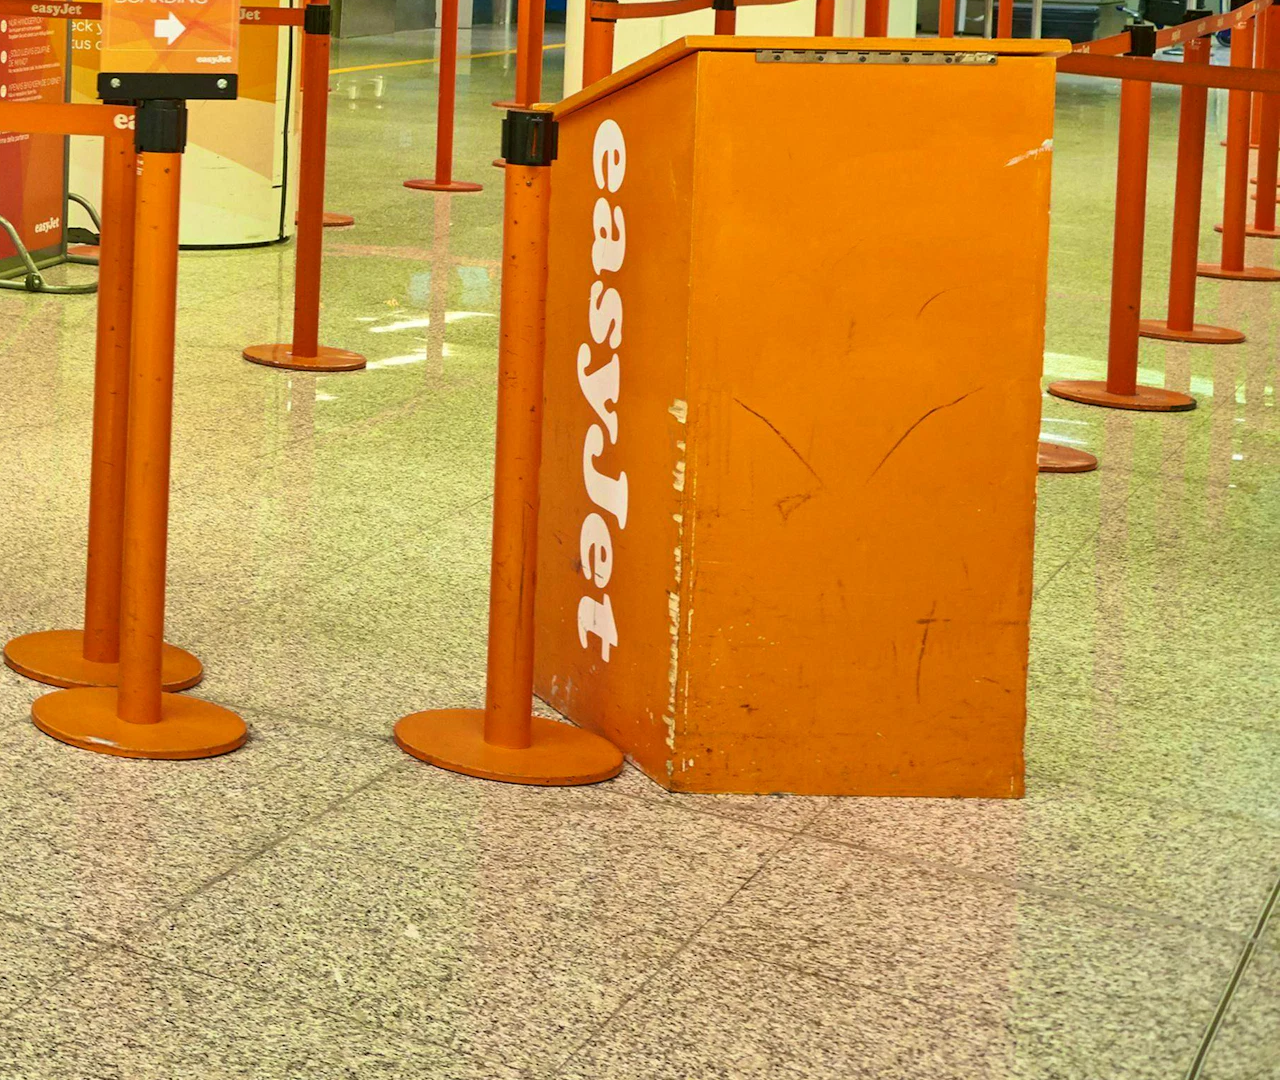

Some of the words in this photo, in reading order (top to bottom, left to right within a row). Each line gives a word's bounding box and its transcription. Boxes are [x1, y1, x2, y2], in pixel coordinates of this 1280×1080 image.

[32, 3, 82, 16] easyJet
[196, 55, 232, 64] easyJet
[35, 217, 59, 233] easyJet
[577, 119, 628, 663] easyJet
